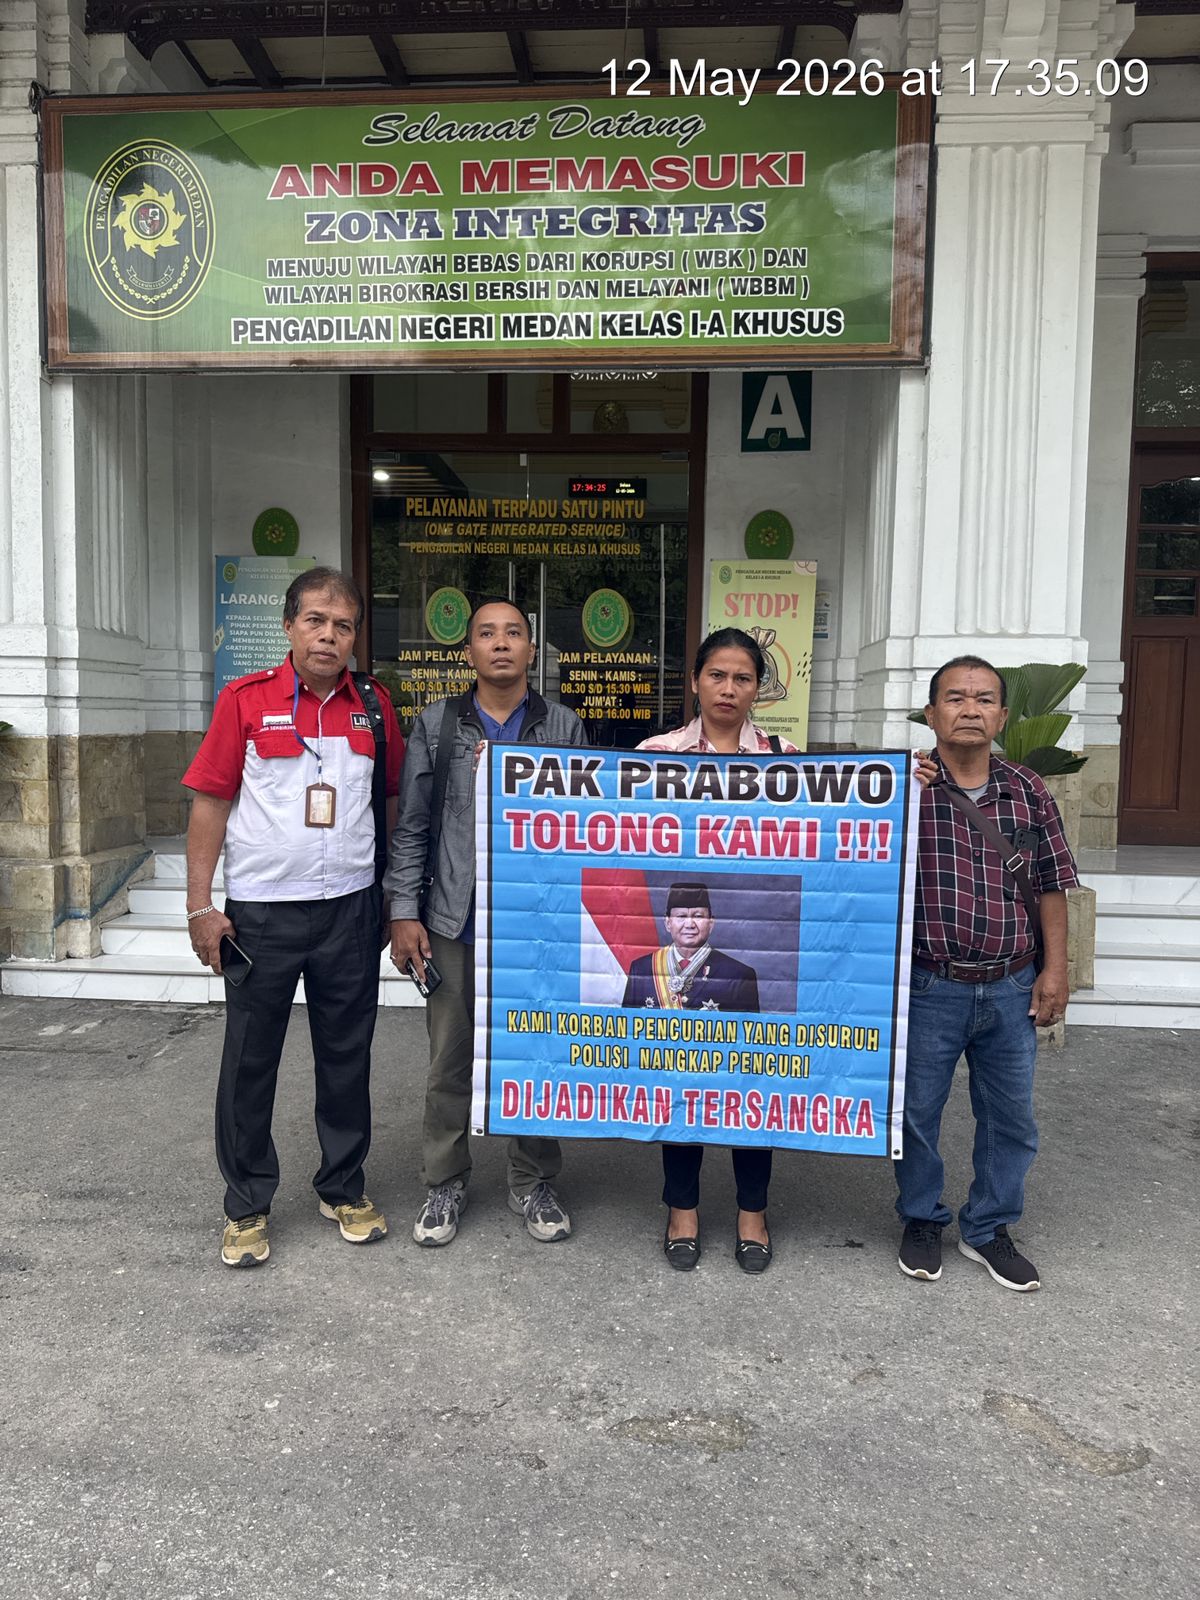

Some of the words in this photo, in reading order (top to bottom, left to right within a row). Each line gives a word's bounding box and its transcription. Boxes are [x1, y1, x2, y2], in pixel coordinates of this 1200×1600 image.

[363, 112, 540, 146] Selamat
[547, 105, 705, 148] Datang
[267, 161, 444, 200] ANDA
[460, 151, 806, 196] MEMASUKI
[95, 154, 139, 230] PENGADILAN
[142, 150, 187, 180] NEGERI
[185, 179, 206, 229] MEDAN
[304, 209, 445, 244] ZONA
[452, 202, 767, 240] INTEGRITAS
[266, 257, 352, 278] MENUJU
[357, 254, 447, 276] WILAYAH
[452, 253, 520, 274] BEBAS
[526, 252, 576, 272] DARI
[581, 250, 675, 272] KORUPSI
[762, 247, 808, 269] DAN
[264, 284, 352, 305] WILAYAH
[357, 281, 469, 304] BIROKRASI
[474, 280, 550, 302] BERSIH
[556, 279, 599, 300] DAN
[606, 277, 710, 299] MELAYANI
[231, 315, 393, 344] PENGADILAN
[399, 313, 496, 342] NEGERI
[500, 311, 593, 341] MEDAN
[599, 310, 684, 339] KELAS
[690, 309, 728, 338] I-A
[731, 308, 844, 337] KHUSUS
[747, 375, 805, 439] A
[572, 484, 606, 492] 17:34:25
[406, 497, 487, 517] PELAYANAN
[493, 499, 557, 518] TERPADU
[562, 499, 598, 519] SATU
[602, 499, 645, 519] PINTU
[425, 521, 453, 537] (ONE
[457, 523, 487, 536] GATE
[491, 523, 567, 536] INTEGRATED
[570, 523, 626, 538] SERVICE)
[410, 542, 471, 553] PENGADILAN
[474, 543, 509, 554] NEGERI
[513, 543, 549, 555] MEDAN
[553, 543, 586, 555] KELAS
[600, 544, 641, 556] KHUSUS
[220, 593, 287, 605] LARANGA
[724, 592, 799, 619] STOP!
[398, 650, 421, 661] JAM
[425, 650, 467, 662] PELAYA
[556, 652, 580, 663] JAM
[584, 652, 650, 664] PELAYANAN
[401, 681, 426, 692] 08.30
[446, 681, 470, 693] 15.30
[411, 668, 439, 679] SENIN
[447, 668, 477, 680] KAMIS
[569, 670, 597, 681] SENIN
[605, 671, 636, 681] KAMIS
[561, 683, 585, 694] 08.30
[588, 683, 603, 694] S/D
[607, 683, 630, 694] 15.30
[633, 683, 651, 694] WIB
[583, 696, 617, 707] JUM'AT
[589, 709, 603, 719] S/D
[607, 709, 630, 720] 16.00
[633, 709, 651, 719] WIB
[502, 752, 604, 799] PAK
[618, 757, 896, 808] PRABOWO
[503, 808, 682, 855] TOLONG
[696, 814, 821, 860] KAMI
[835, 819, 893, 862] !!!
[507, 1010, 551, 1034] KAMI
[557, 1013, 627, 1039] KORBAN
[633, 1016, 738, 1044] PENCURIAN
[743, 1020, 790, 1047] YANG
[795, 1023, 879, 1052] DISURUH
[570, 1043, 629, 1068] POLISI
[639, 1047, 723, 1073] NANGKAP
[728, 1051, 810, 1078] PENCURI
[501, 1079, 673, 1126] DIJADIKAN
[682, 1088, 876, 1138] TERSANGKA
